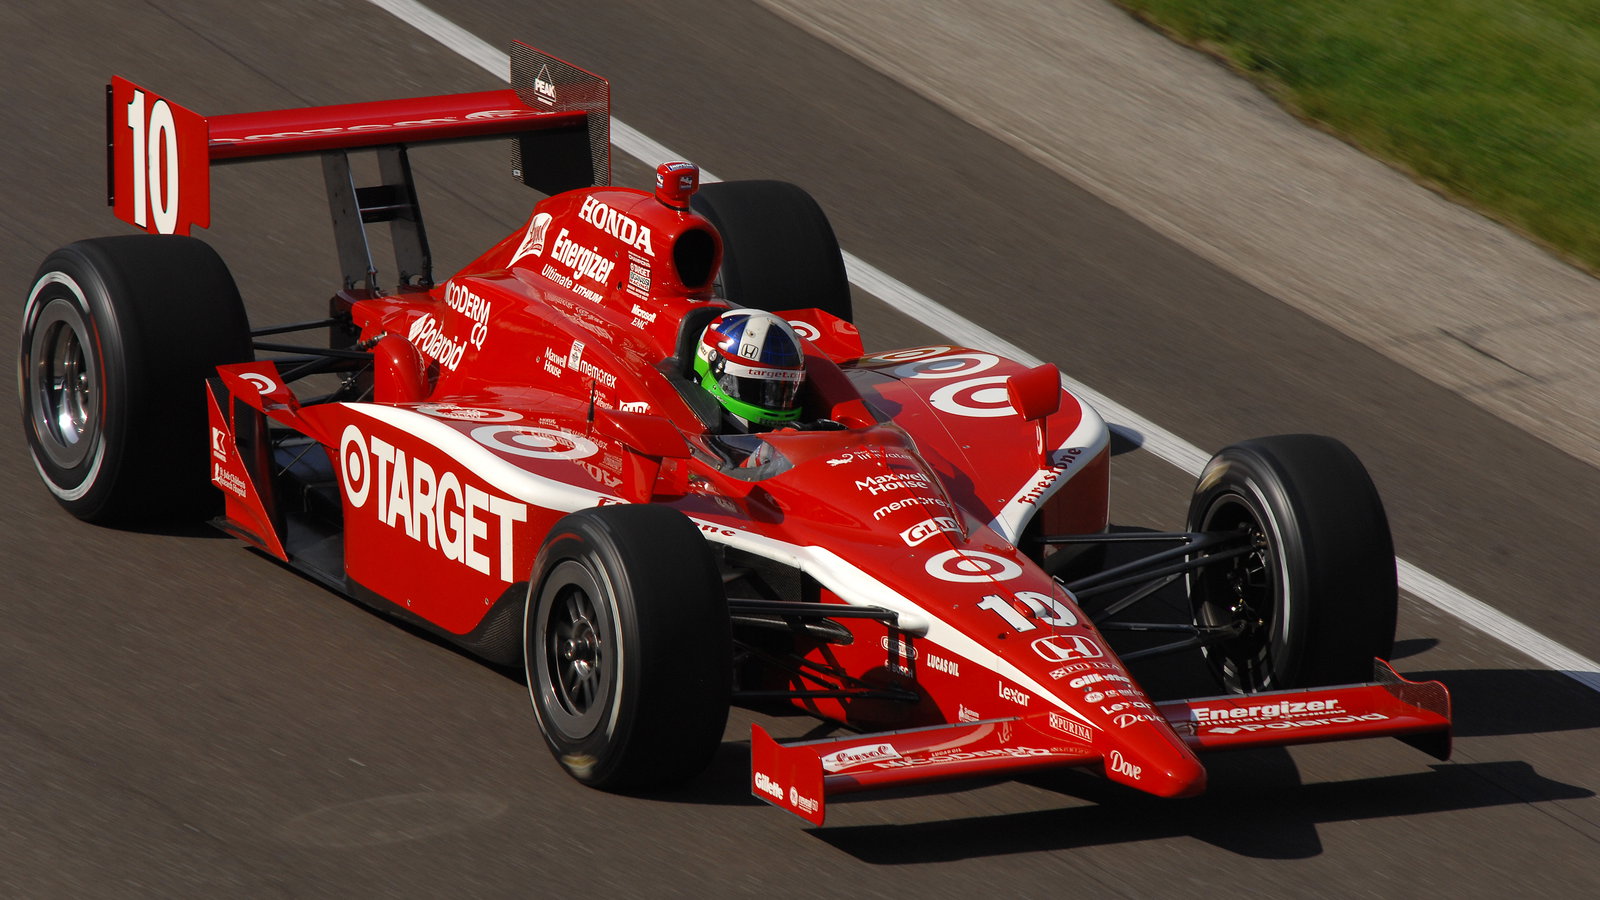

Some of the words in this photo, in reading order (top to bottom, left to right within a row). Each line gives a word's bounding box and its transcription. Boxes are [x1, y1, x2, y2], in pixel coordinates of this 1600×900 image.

[534, 78, 555, 98] PEAK
[127, 89, 180, 234] 10
[578, 195, 655, 257] HONDA
[551, 227, 615, 284] Energizer
[541, 264, 573, 289] Ultimate
[572, 283, 604, 304] LITHIUM
[414, 317, 467, 372] Polaroid
[470, 322, 487, 351] CQ
[543, 346, 568, 369] Maxwell
[543, 359, 562, 378] House
[580, 360, 617, 389] memorex
[855, 472, 931, 491] Maxwell
[868, 480, 929, 496] House
[1017, 448, 1082, 508] Firestone
[371, 435, 527, 583] TARGET
[908, 519, 959, 542] GLAD
[976, 591, 1078, 633] 10
[927, 653, 948, 674] LUCAS
[949, 661, 960, 677] OIL
[998, 680, 1031, 707] Lexar
[1190, 699, 1339, 721] Energizer
[1238, 713, 1390, 732] Polaroid
[1057, 715, 1090, 739] PURINA
[1110, 750, 1142, 780] Dove
[755, 771, 784, 800] Gillette
